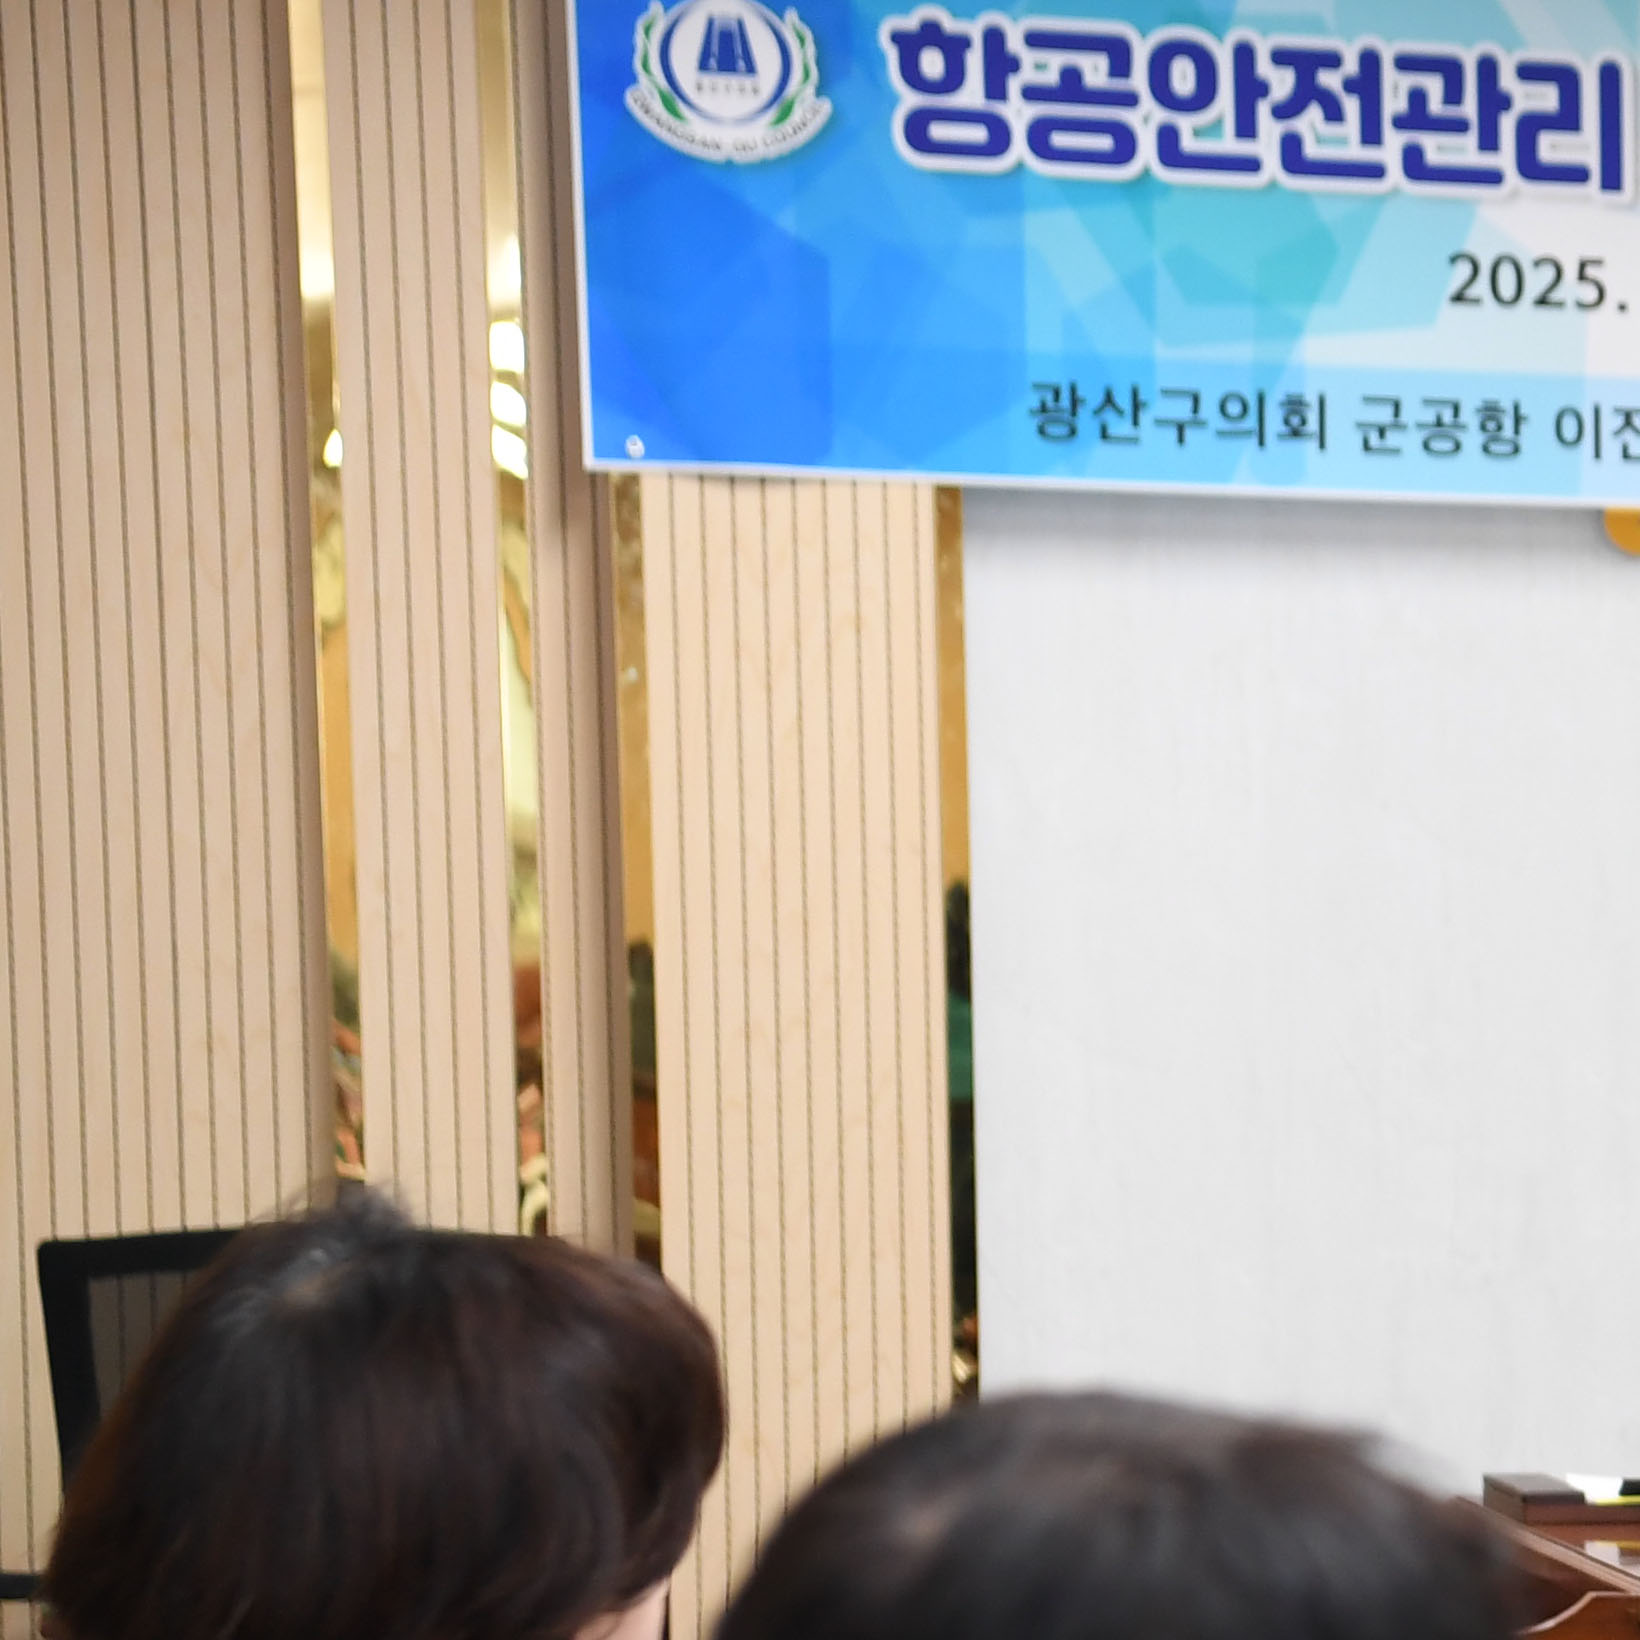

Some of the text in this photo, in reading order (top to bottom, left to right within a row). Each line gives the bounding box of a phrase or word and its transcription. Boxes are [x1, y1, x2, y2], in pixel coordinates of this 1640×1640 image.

[890, 18, 1622, 192] 항공안전관리
[1450, 253, 1627, 312] 2025.
[1030, 383, 1326, 452] 광산구의회
[1356, 397, 1527, 458] 군공항
